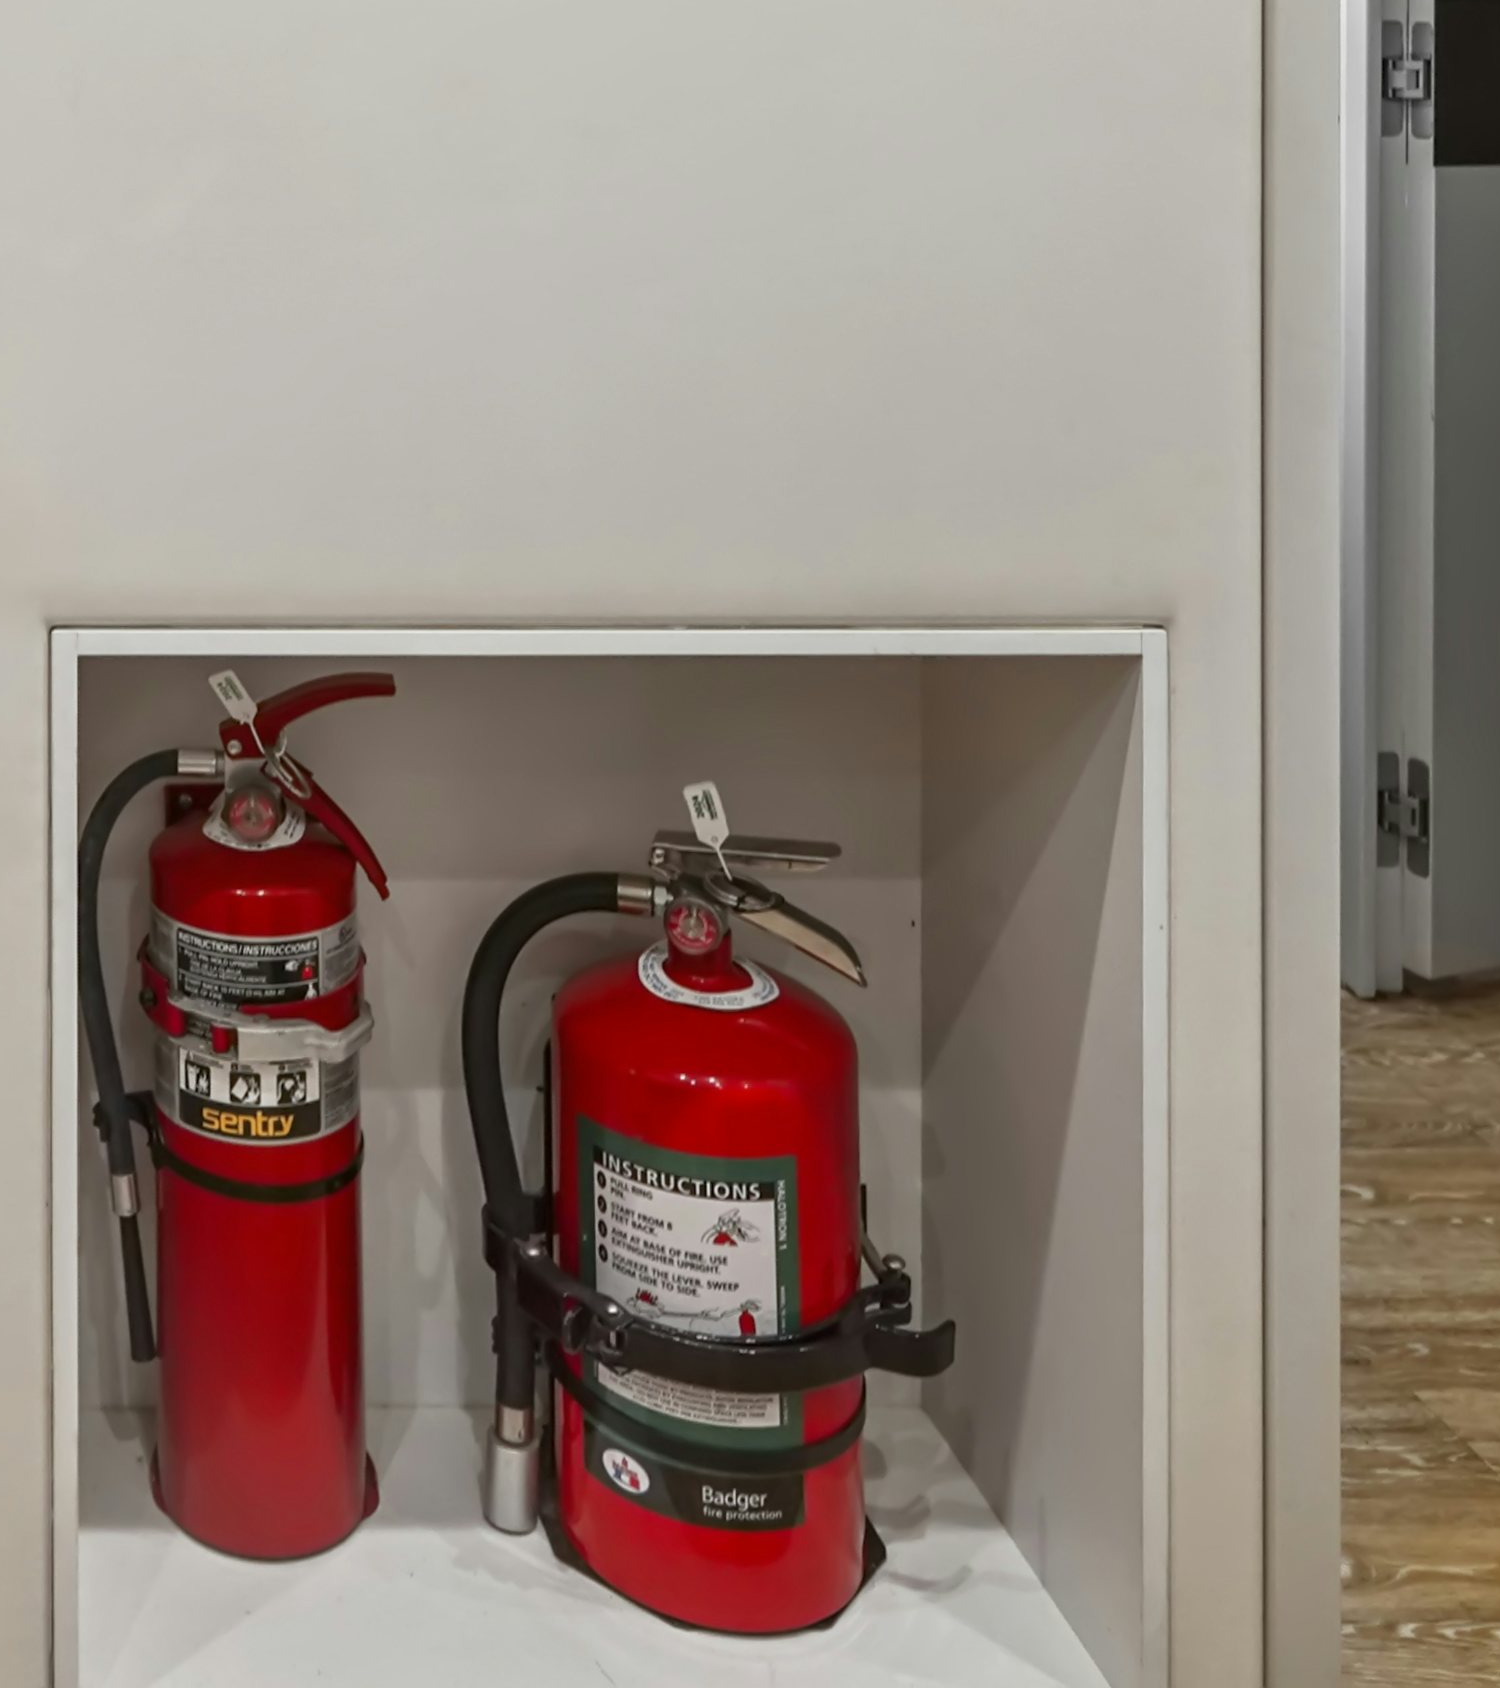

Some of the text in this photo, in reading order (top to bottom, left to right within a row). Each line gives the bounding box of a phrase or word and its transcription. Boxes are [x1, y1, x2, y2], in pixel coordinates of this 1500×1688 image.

[202, 1107, 295, 1137] sentry
[603, 1151, 761, 1200] INSTRUCTIONS
[610, 1177, 653, 1200] PULL RING
[610, 1213, 658, 1236] FEET BACK.
[611, 1202, 635, 1218] START
[637, 1210, 664, 1228] FROM
[778, 1179, 788, 1242] HALOTRON
[611, 1226, 627, 1239] AIM
[630, 1234, 641, 1244] AT
[643, 1240, 666, 1255] BASE
[669, 1247, 681, 1258] OF
[710, 1255, 728, 1266] USE
[611, 1237, 721, 1275] EXTINGUISHER UPRIGHT.
[612, 1251, 648, 1273] SQUEEZE
[652, 1267, 668, 1280] THE
[707, 1280, 740, 1292] SWEEP
[612, 1262, 636, 1280] FROM
[639, 1273, 657, 1287] SIDE
[661, 1281, 674, 1292] TO
[702, 1485, 768, 1511] Badger
[703, 1506, 782, 1522] fire protection
